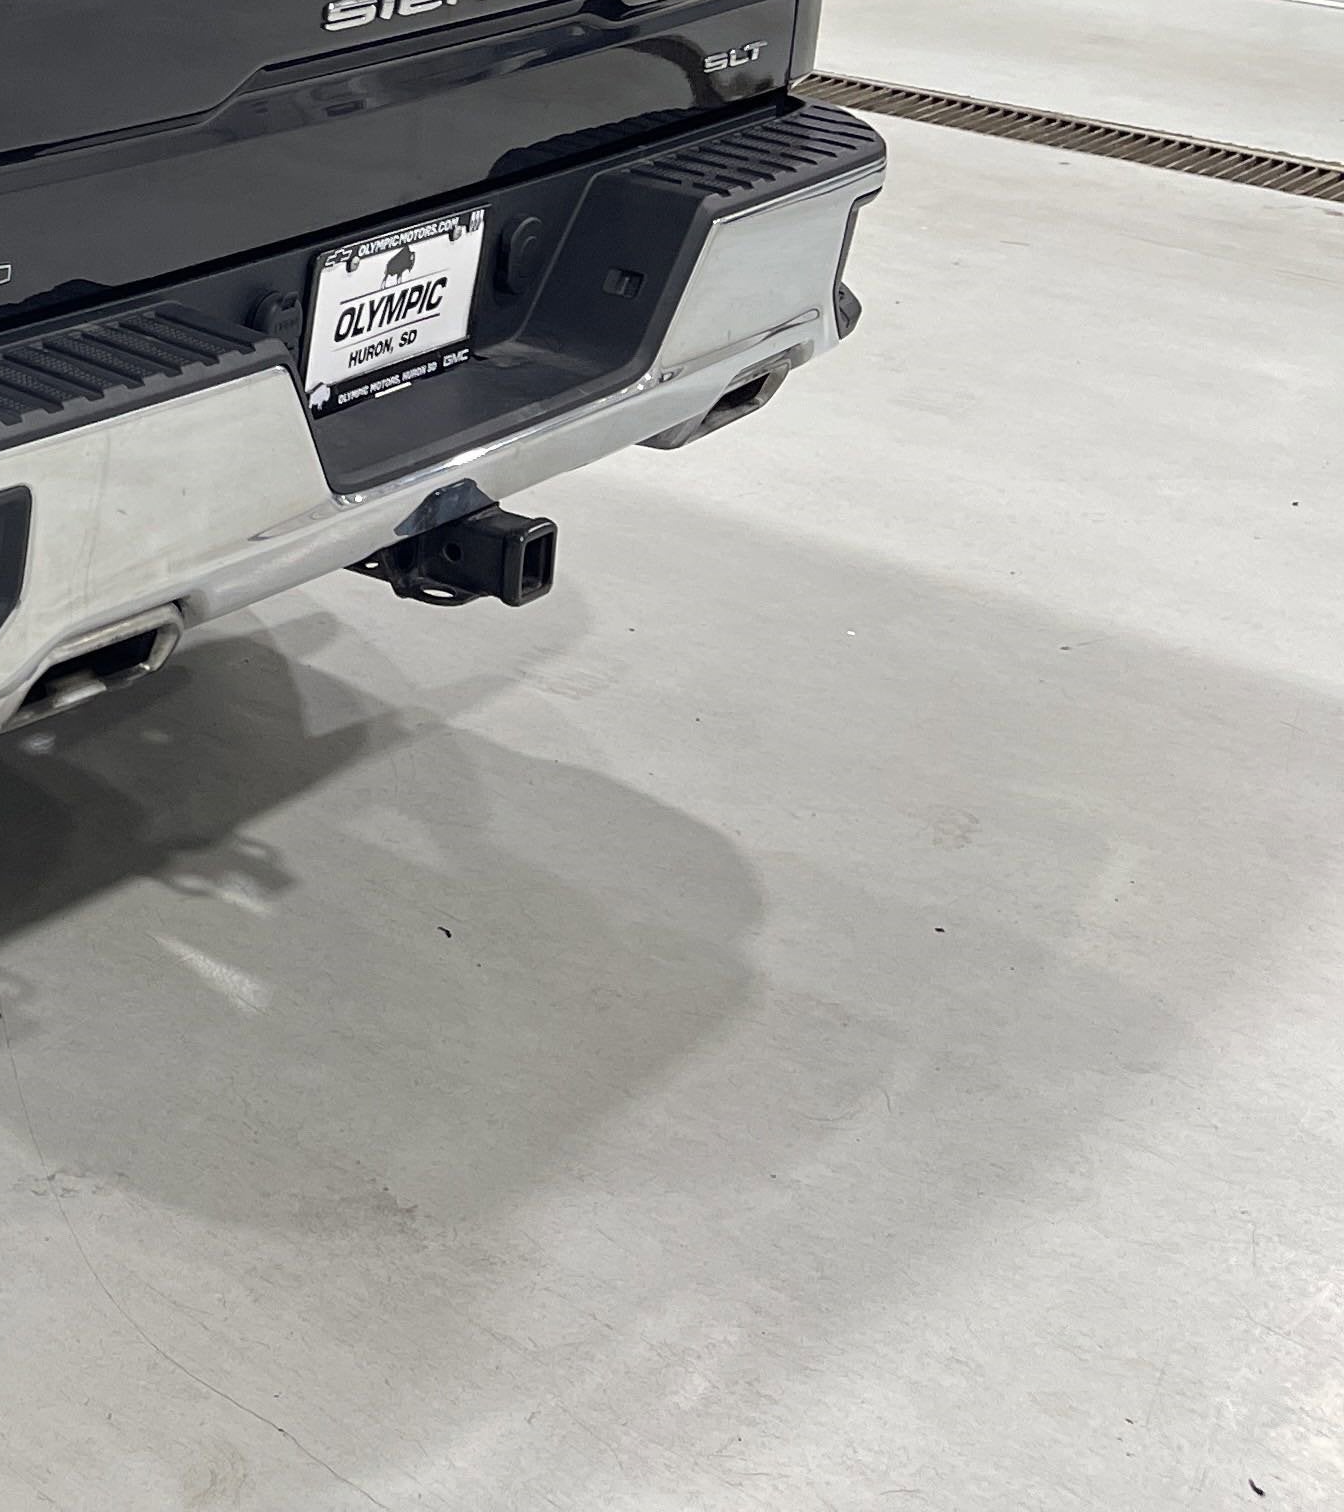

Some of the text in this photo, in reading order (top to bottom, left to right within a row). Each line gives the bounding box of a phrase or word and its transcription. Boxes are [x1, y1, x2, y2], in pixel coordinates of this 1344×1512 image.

[703, 41, 769, 74] SLT
[334, 276, 448, 343] OLYMPIC
[348, 329, 418, 369] HURON, SD
[442, 349, 470, 368] GMC
[338, 384, 369, 404] OLYMPIC
